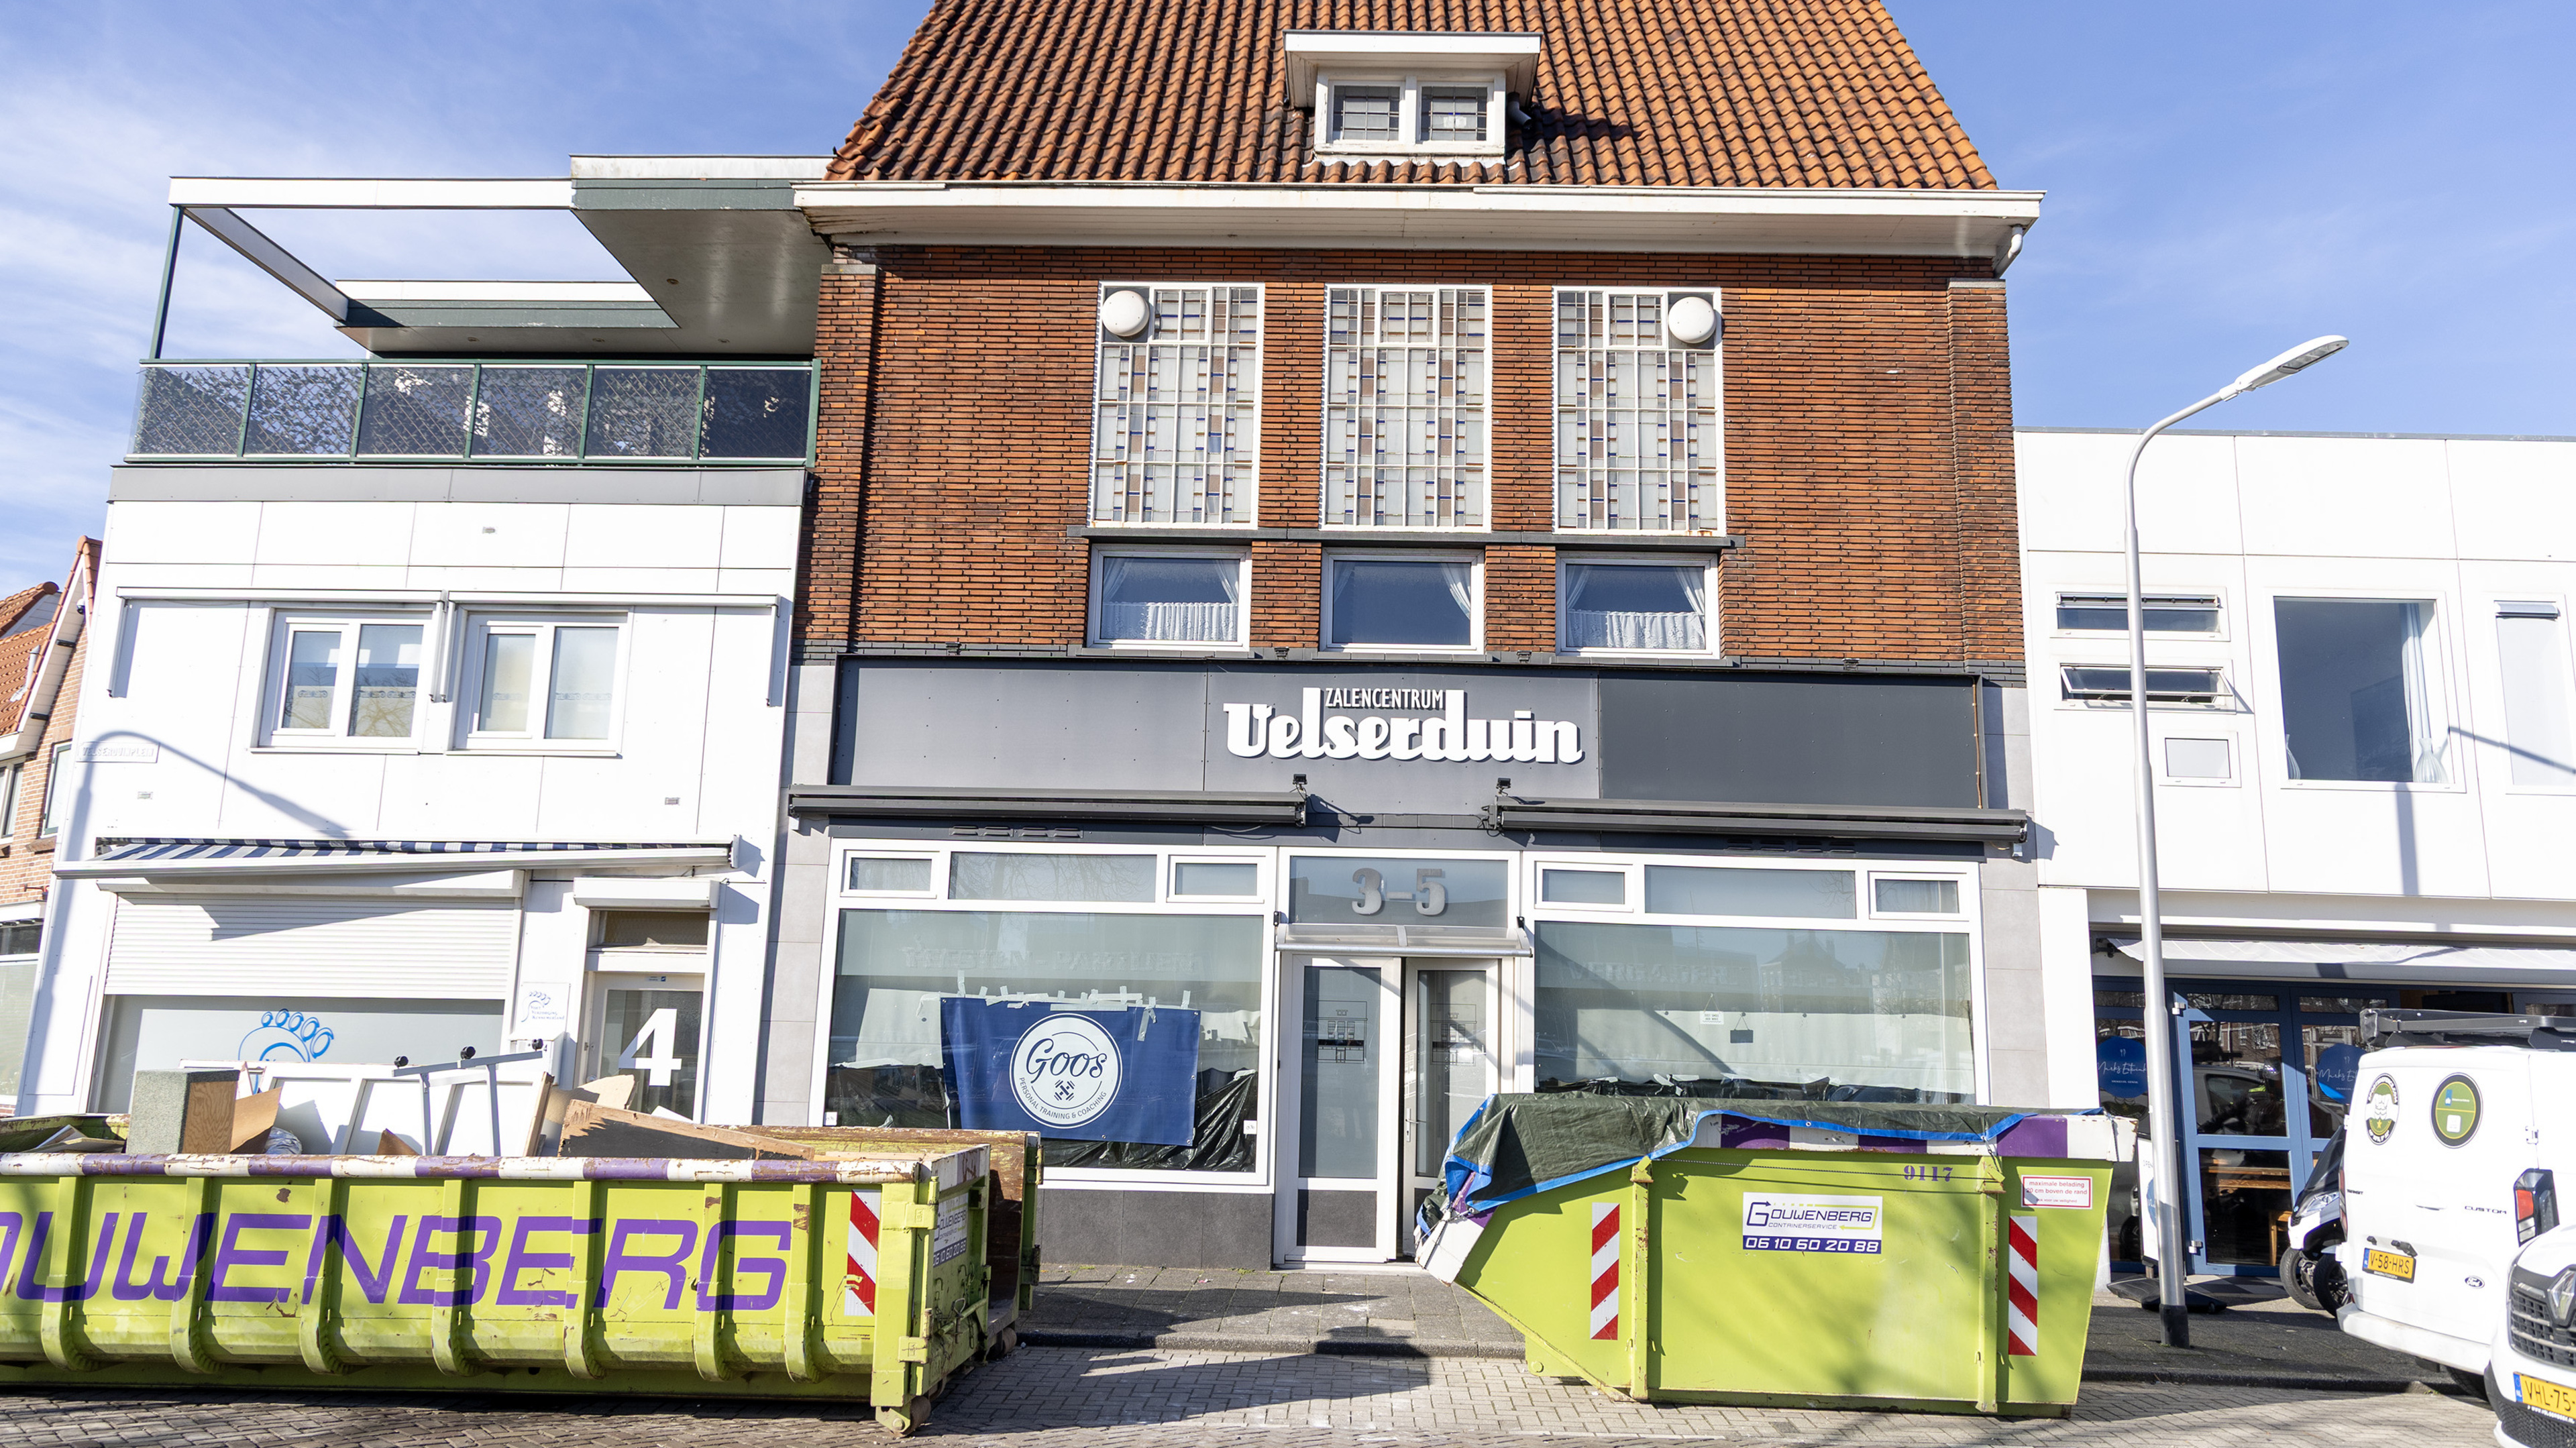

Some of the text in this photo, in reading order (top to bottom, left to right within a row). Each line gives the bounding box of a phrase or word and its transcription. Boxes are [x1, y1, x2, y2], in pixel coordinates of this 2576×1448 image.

[1325, 688, 1444, 709] ZALENCENTRUM
[619, 1008, 682, 1087] 4
[1026, 1038, 1107, 1084] Goos
[1019, 1077, 1040, 1109] PERSONAL
[1039, 1106, 1071, 1119] TRAINING
[1077, 1091, 1107, 1117] COACHING
[1904, 1165, 1953, 1182] 9117
[1746, 1201, 1872, 1227] GOUWENBERG
[2465, 1205, 2507, 1215] CUSTOM
[1768, 1222, 1837, 1230] CONTAINERSERVICE
[1746, 1237, 1879, 1252] 06 10 60 20 88
[2370, 1252, 2410, 1275] V-58-HRS
[2524, 1380, 2576, 1412] VHL-75-
